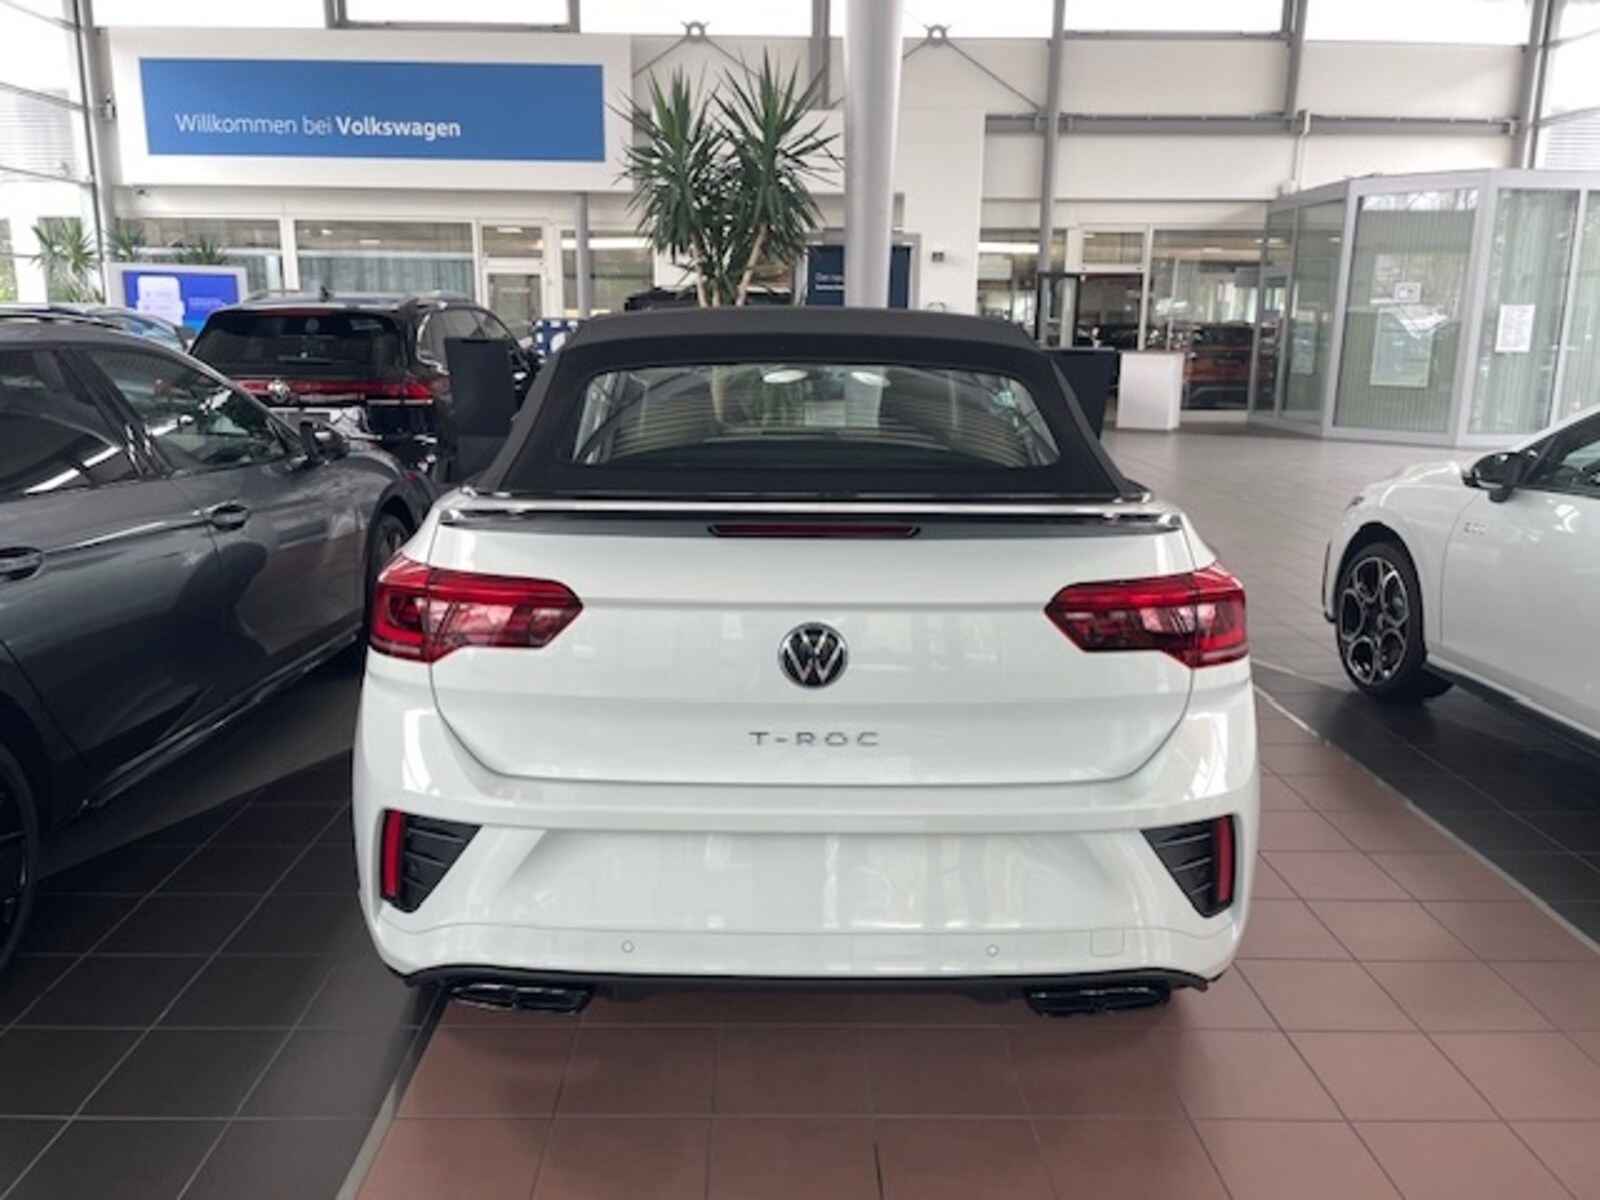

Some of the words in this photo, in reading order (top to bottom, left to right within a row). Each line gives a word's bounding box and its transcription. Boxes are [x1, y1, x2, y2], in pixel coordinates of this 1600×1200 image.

[175, 113, 298, 134] Willkommen
[302, 115, 333, 135] bei
[335, 116, 462, 141] Volkswagen
[778, 622, 848, 689] VW
[748, 731, 879, 747] T-ROC
